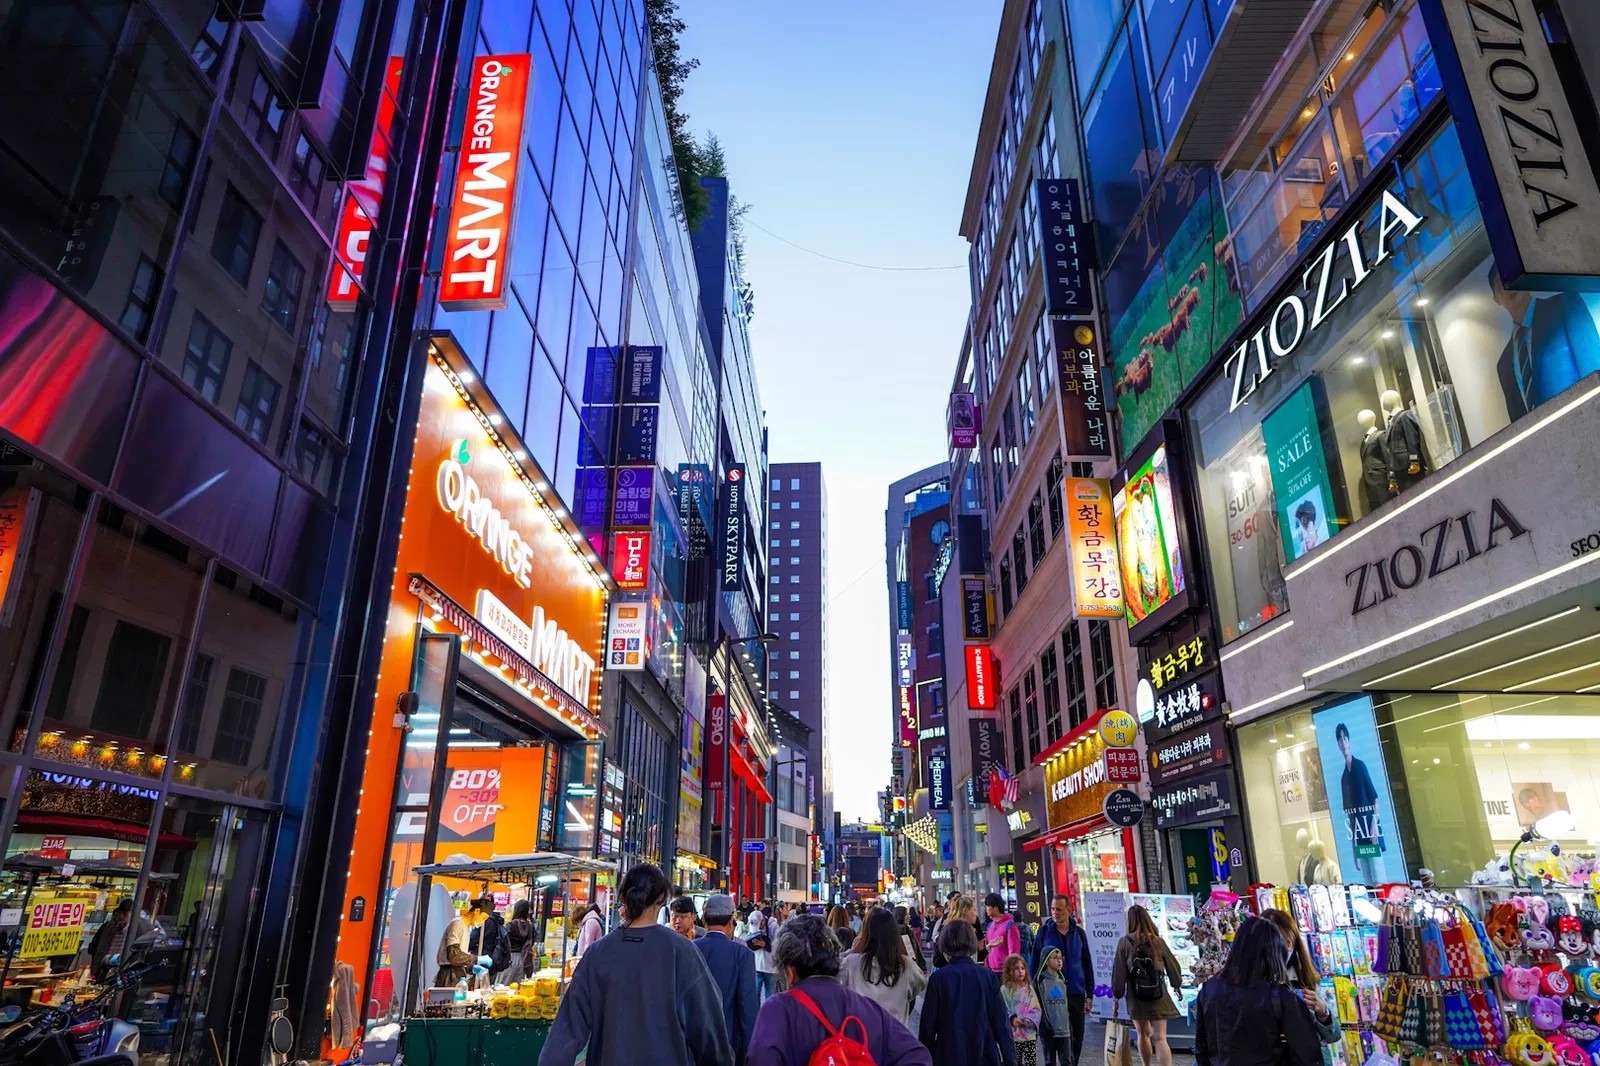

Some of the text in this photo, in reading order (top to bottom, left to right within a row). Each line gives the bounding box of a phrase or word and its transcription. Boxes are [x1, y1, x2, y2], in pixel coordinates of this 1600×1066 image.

[1466, 0, 1578, 228] ZIOZIA
[450, 60, 511, 293] ORANGE MART
[1065, 291, 1078, 305] 2
[1224, 189, 1424, 414] ZIOZIA
[643, 362, 653, 386] HOTEL
[1062, 348, 1082, 396] 피부과
[1079, 348, 1106, 451] 아름다운 나라
[1278, 433, 1313, 474] SALE
[615, 500, 638, 512] 의원
[616, 487, 651, 500] 슬림영
[1230, 482, 1257, 518] SUIT
[437, 460, 533, 589] ORANGE
[725, 485, 739, 584] HOTEL SKYPARK
[1571, 530, 1600, 557] SEO
[1077, 504, 1110, 598] 황금목장
[1345, 498, 1527, 616] ZIOZIA
[531, 605, 595, 708] MART
[974, 648, 984, 685] K-BEAUTY
[1151, 636, 1204, 689] 황금목장
[711, 706, 724, 745] SPAO
[908, 717, 915, 729] 2
[979, 721, 990, 761] SAVOY
[1108, 751, 1138, 762] 피부과
[1159, 745, 1181, 764] 아름다운
[1180, 740, 1194, 757] 나라
[1193, 732, 1212, 752] 피부과
[451, 769, 501, 790] 80%
[932, 760, 943, 809] MEDIHEAL
[1051, 759, 1104, 803] K-BEAUTY SHOP
[1110, 765, 1139, 779] 전문의
[453, 803, 498, 823] OFF
[1344, 814, 1384, 841] SALE
[31, 903, 86, 930] 임대문의
[1092, 929, 1113, 938] 1,000
